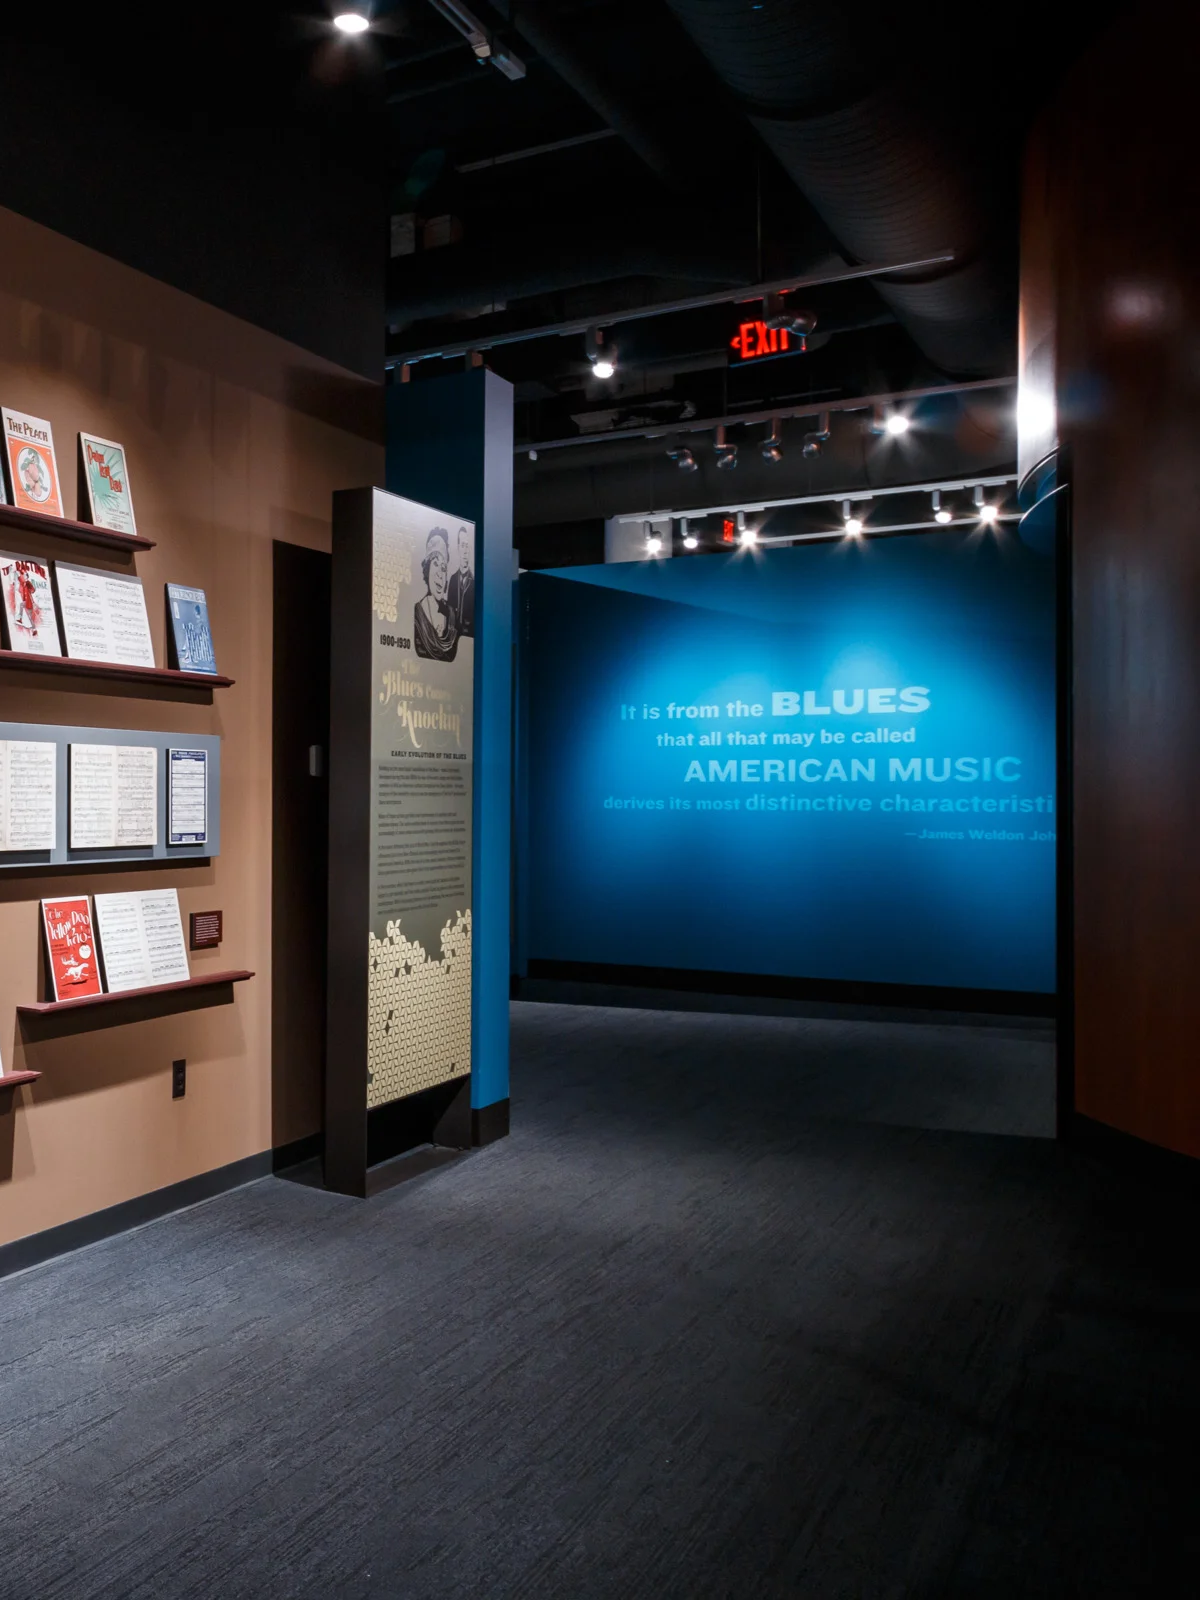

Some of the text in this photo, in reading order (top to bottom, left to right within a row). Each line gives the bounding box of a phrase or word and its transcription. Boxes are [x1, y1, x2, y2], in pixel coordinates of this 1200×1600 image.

[6, 417, 49, 442] THE PEACH
[380, 633, 411, 650] 1900-1930
[379, 670, 424, 705] Blues
[620, 686, 931, 720] It is from the BLUES
[656, 727, 916, 748] that all that may be called
[683, 756, 1023, 783] AMERICAN MUSIC
[603, 795, 665, 811] derives
[669, 796, 691, 811] its
[696, 798, 741, 811] most
[745, 793, 872, 813] distinctive
[968, 829, 1024, 841] Weldon
